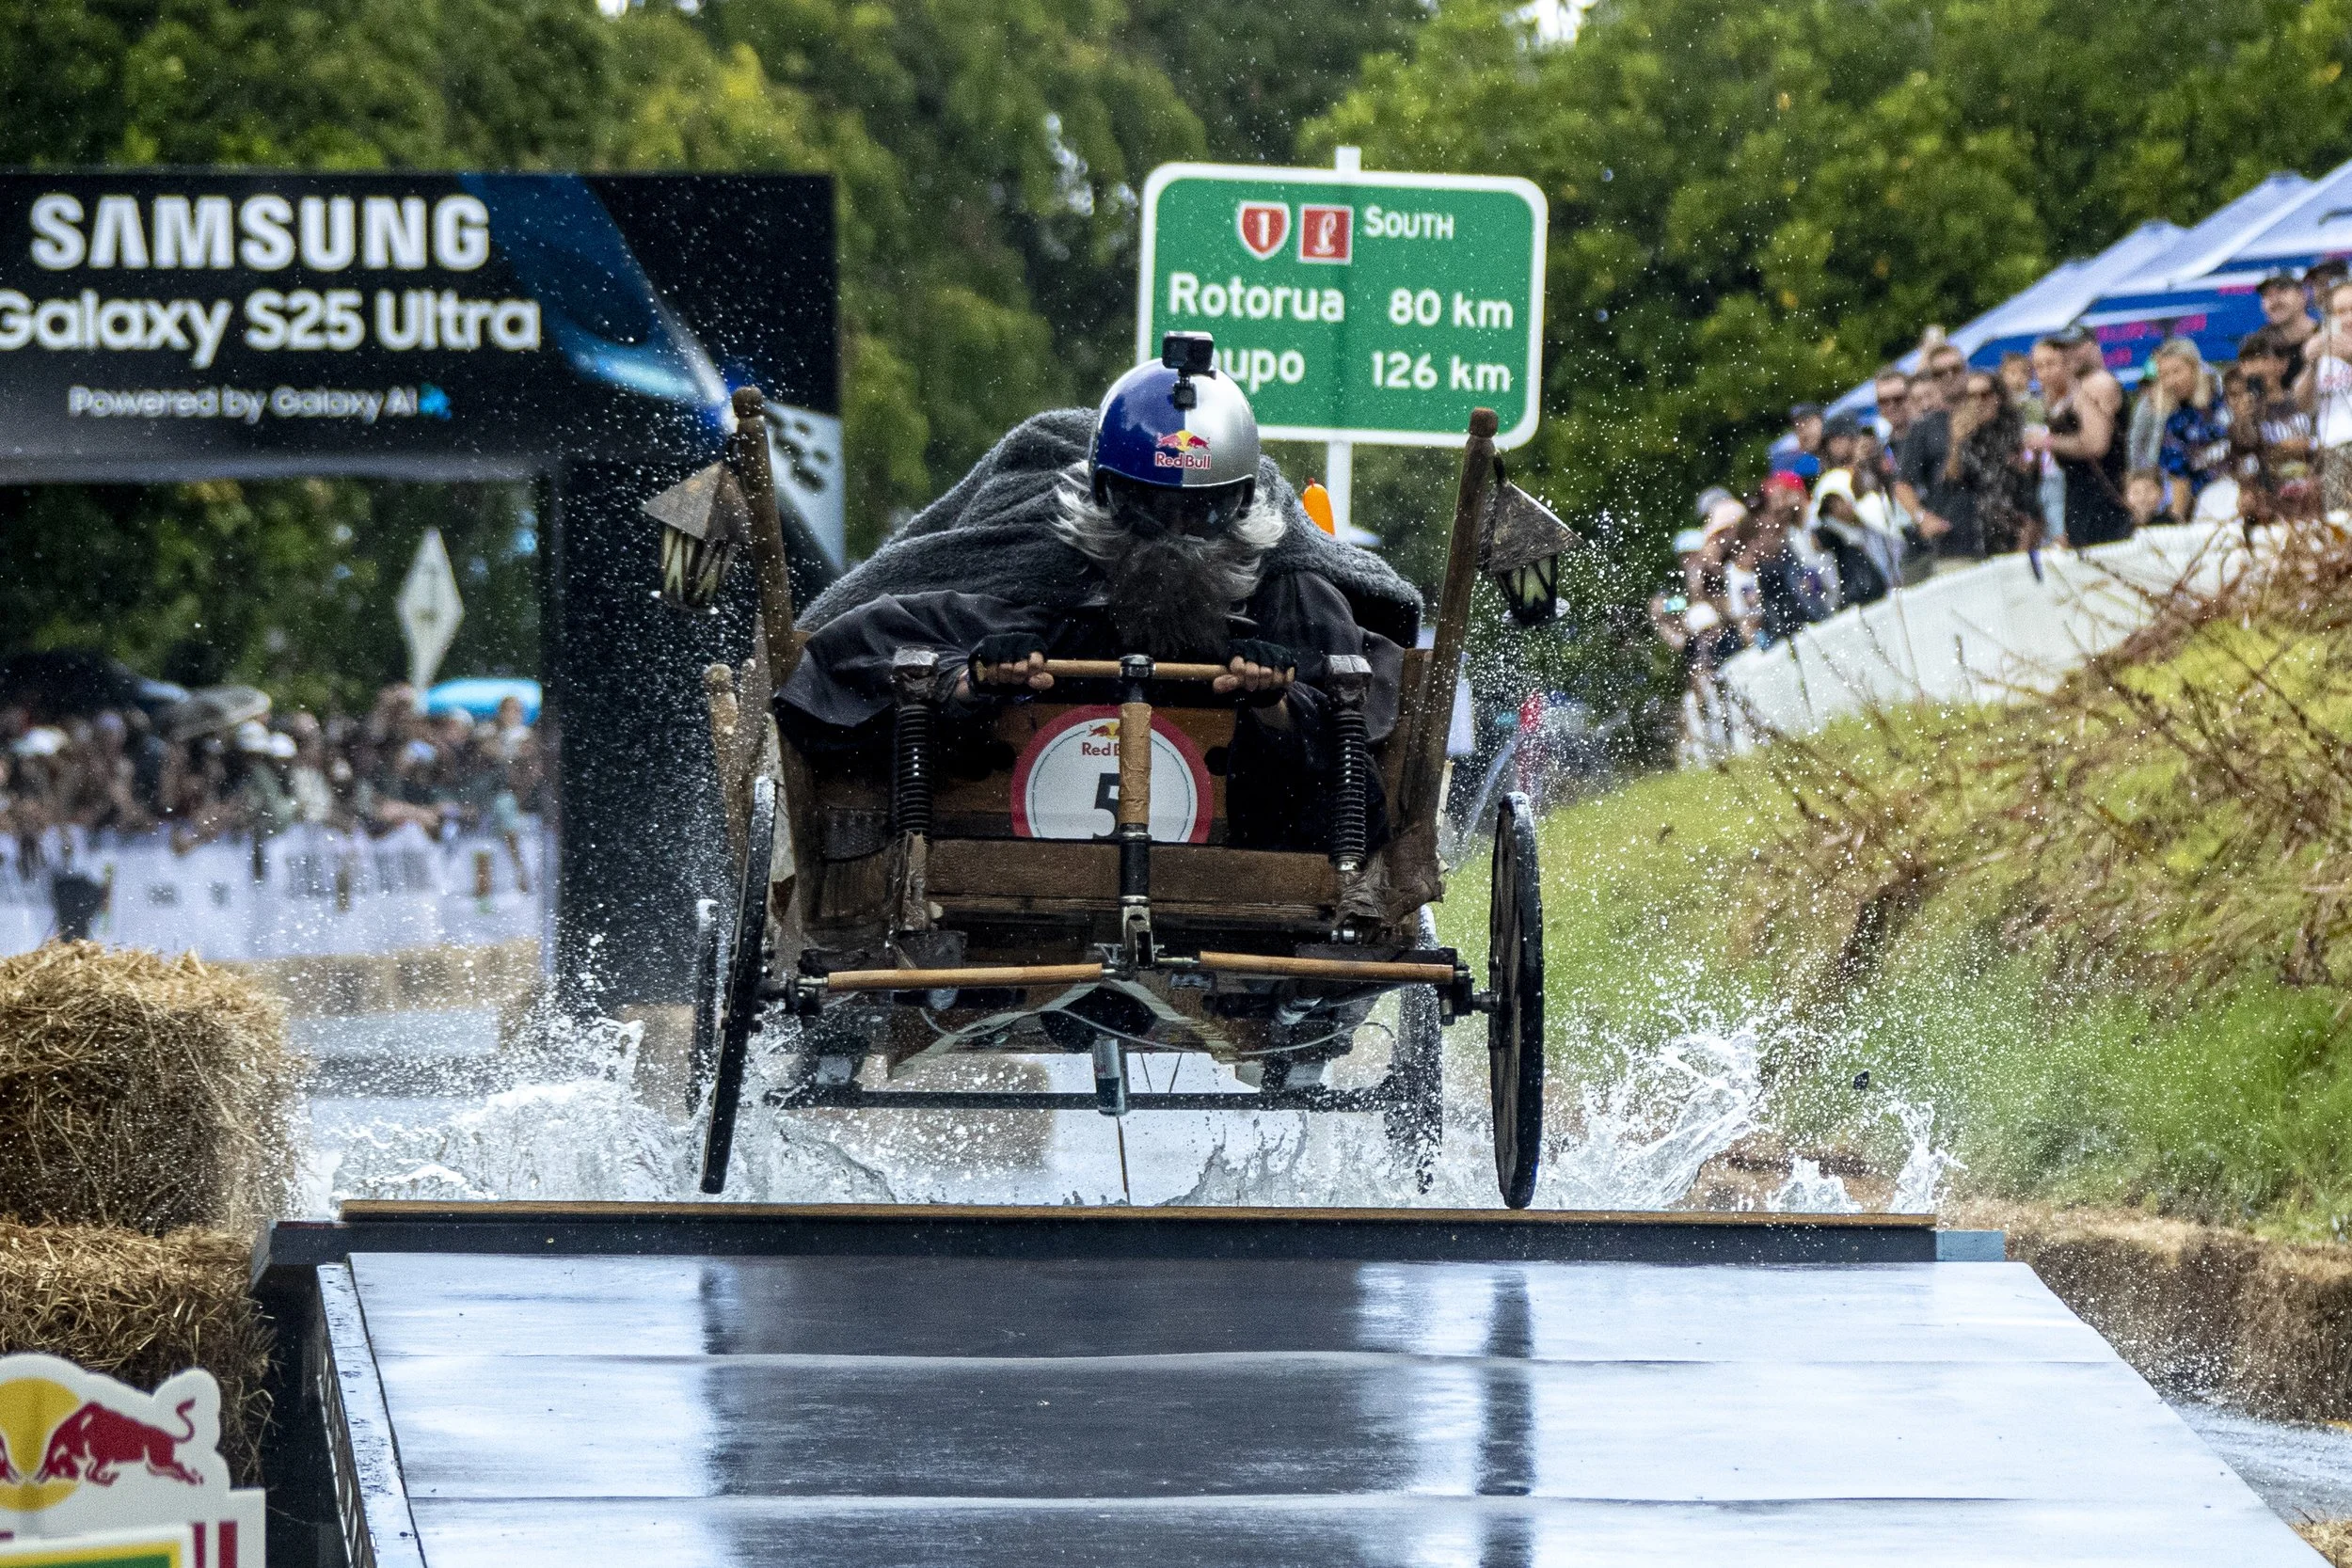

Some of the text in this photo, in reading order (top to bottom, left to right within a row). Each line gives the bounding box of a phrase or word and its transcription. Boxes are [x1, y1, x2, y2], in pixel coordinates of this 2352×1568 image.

[30, 193, 490, 271] SAMSUNG
[1257, 211, 1270, 248] 1
[1168, 272, 1514, 329] Rotorua 80 km
[0, 288, 541, 369] Galaxy S25 Ultra
[1215, 349, 1511, 394] upo 126 km
[69, 384, 418, 424] Powered by Galaxy AI
[1154, 452, 1211, 468] Red Bull
[1082, 741, 1111, 756] Red
[1092, 772, 1120, 839] 5
